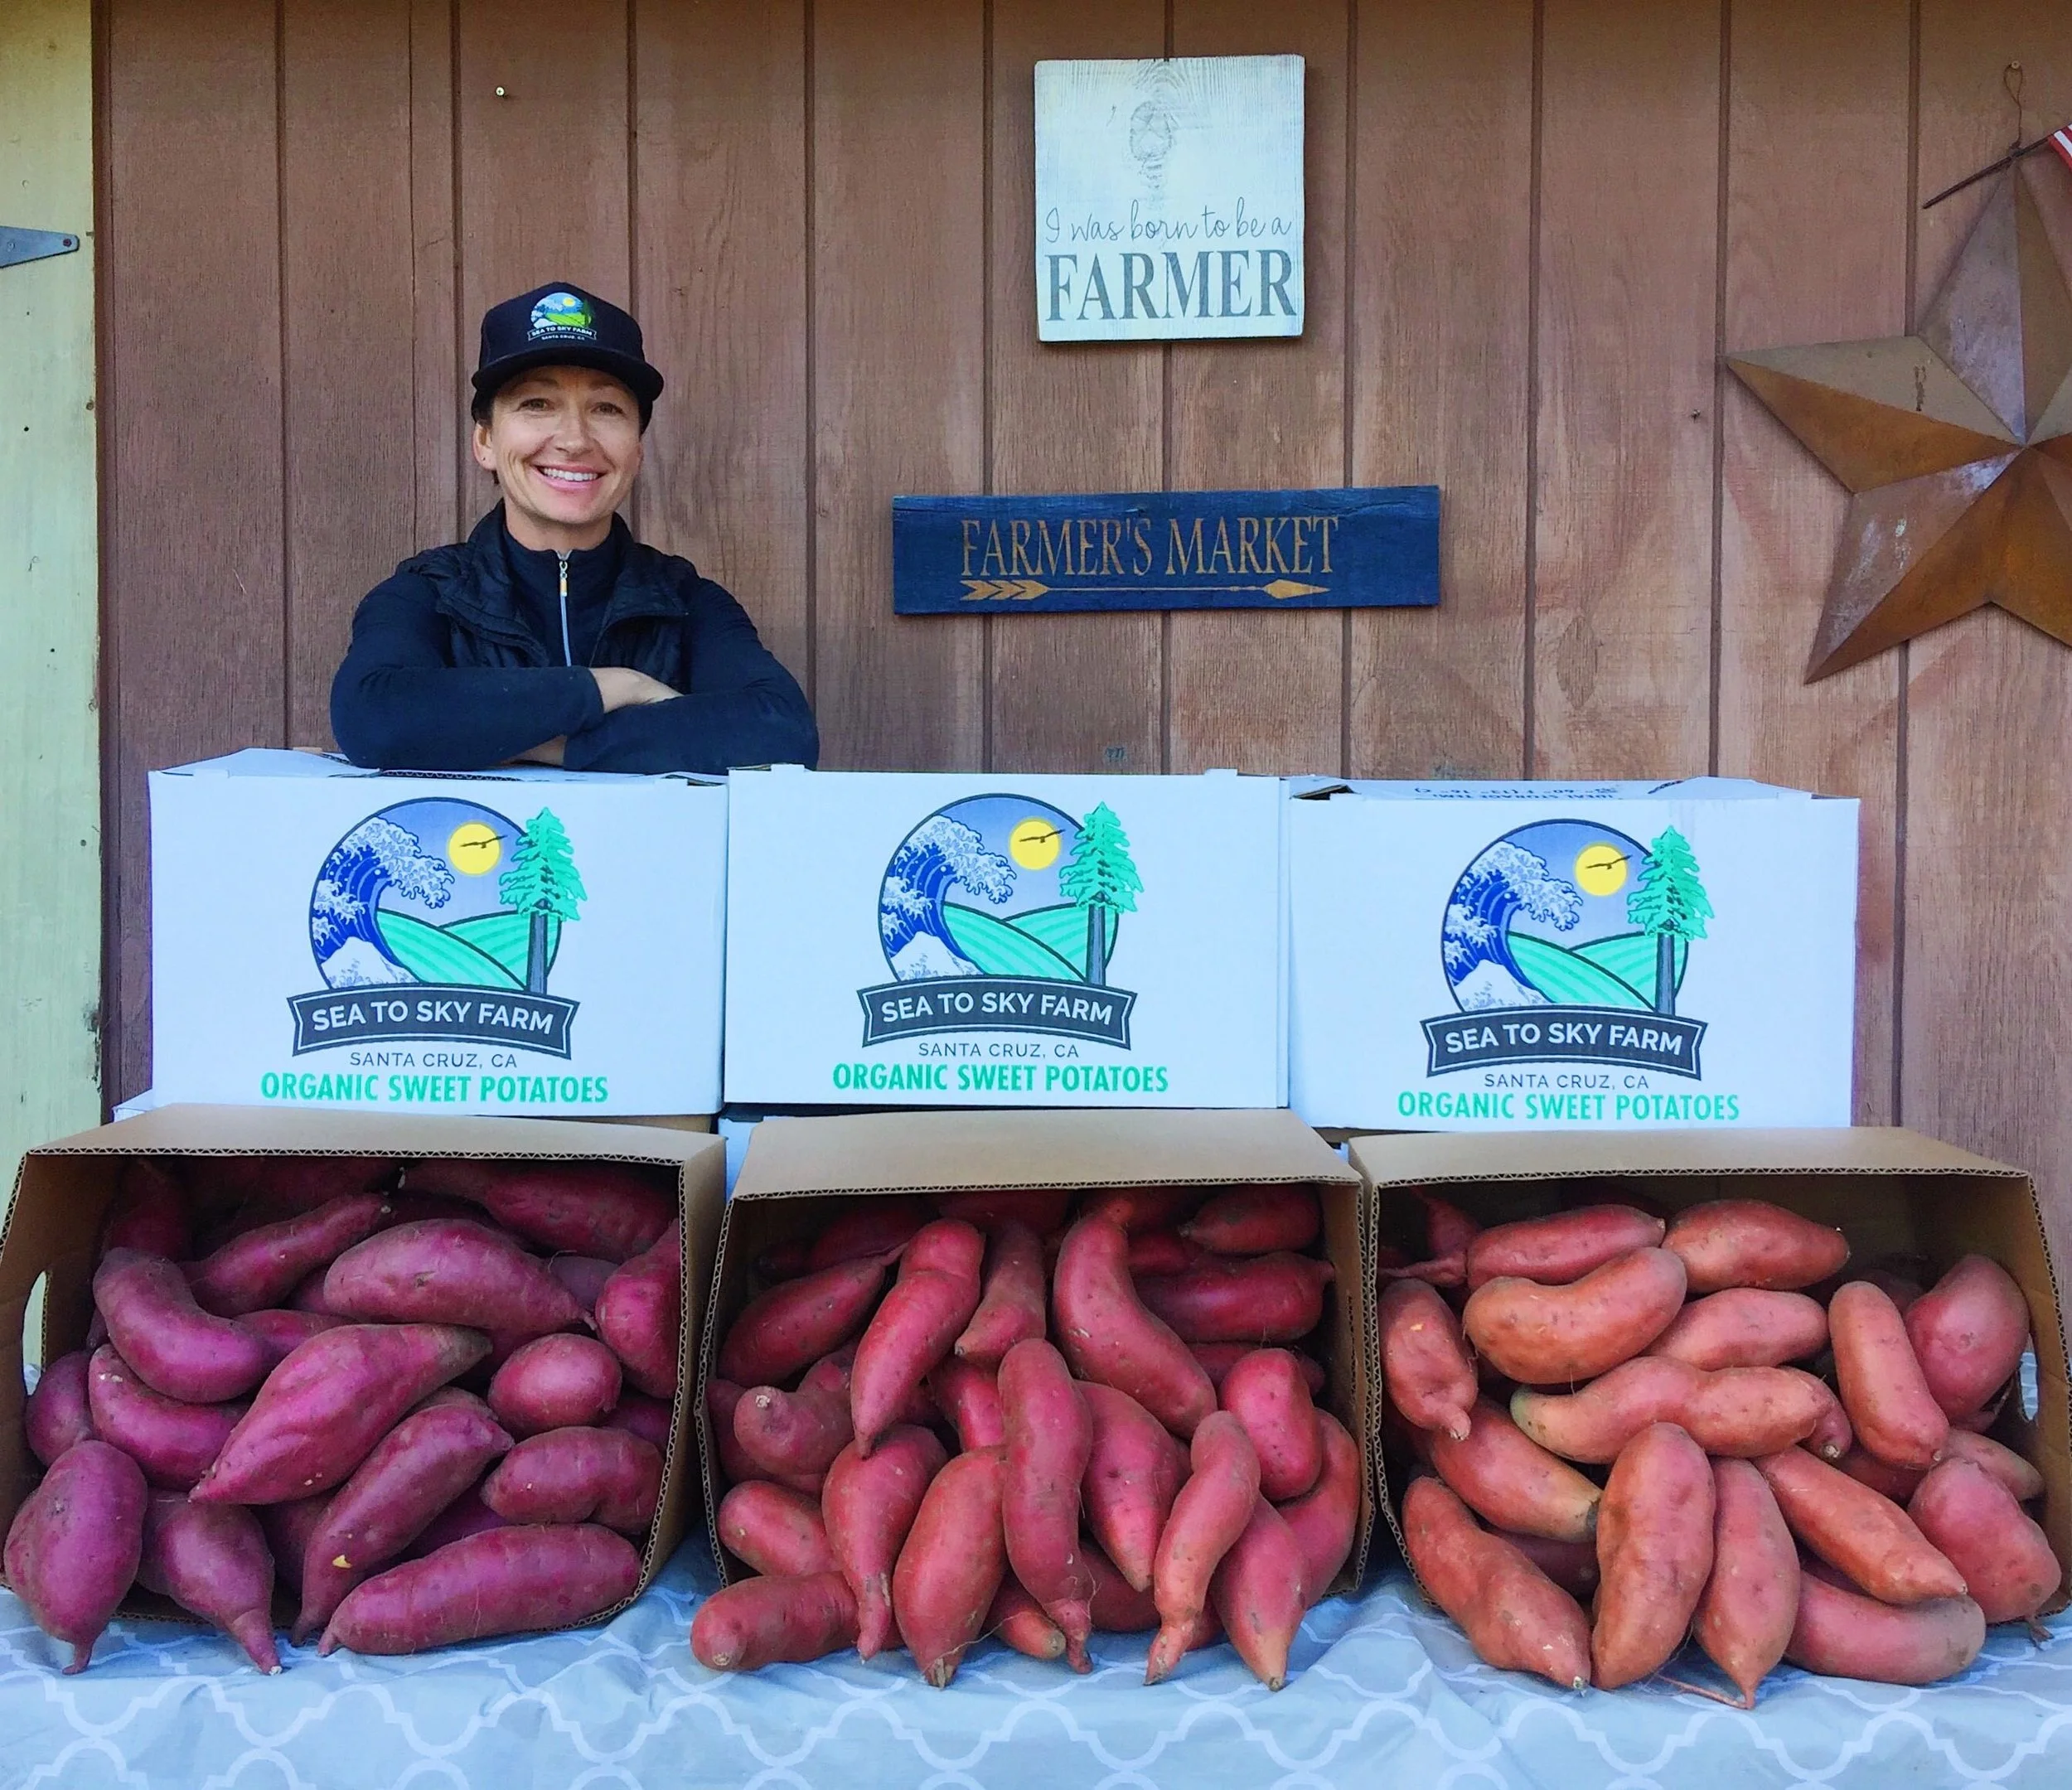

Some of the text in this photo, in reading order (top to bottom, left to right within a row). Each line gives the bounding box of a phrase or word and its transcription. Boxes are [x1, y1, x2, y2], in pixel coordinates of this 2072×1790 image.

[1045, 196, 1292, 243] I was born to be a
[1045, 249, 1297, 322] FARMER
[531, 328, 545, 336] SEA
[573, 327, 593, 336] FARM
[960, 515, 1339, 576] FARMER'S MARKET
[312, 1000, 554, 1035] SEA TO SKY FARM
[881, 992, 1113, 1026] SEA TO SKY FARM
[918, 1043, 1079, 1060] SANTA CRUZ, CA
[1445, 1023, 1682, 1057] SEA TO SKY FARM
[350, 1052, 518, 1069] SANTA CRUZ, CA
[261, 1072, 609, 1103] ORGANIC SWEET POTATOES
[833, 1063, 1169, 1093] ORGANIC SWEET POTATOES
[1484, 1074, 1649, 1090] SANTA CRUZ, CA
[1398, 1091, 1740, 1121] ORGANIC SWEET POTATOES
